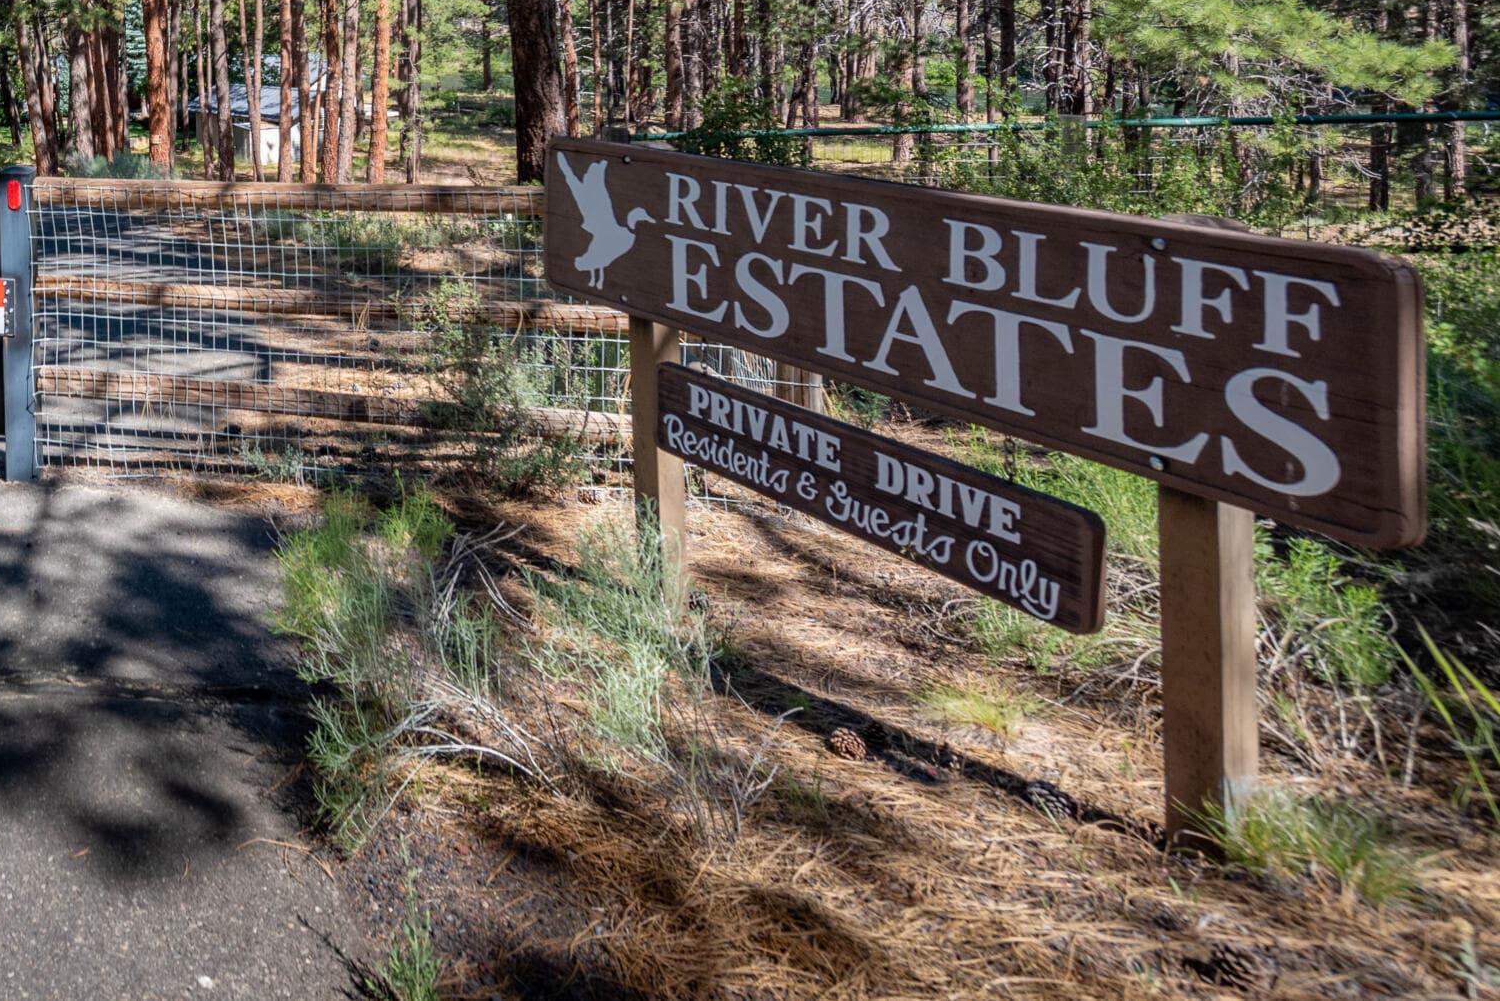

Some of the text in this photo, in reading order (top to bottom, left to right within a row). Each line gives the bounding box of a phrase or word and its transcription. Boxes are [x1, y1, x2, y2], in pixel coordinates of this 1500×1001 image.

[664, 172, 1341, 358] RIVER BLUFF
[665, 234, 1341, 497] ESTATES
[687, 382, 1021, 544] PRIVATE DRIVE
[663, 413, 1060, 620] Residents & Guests Only
